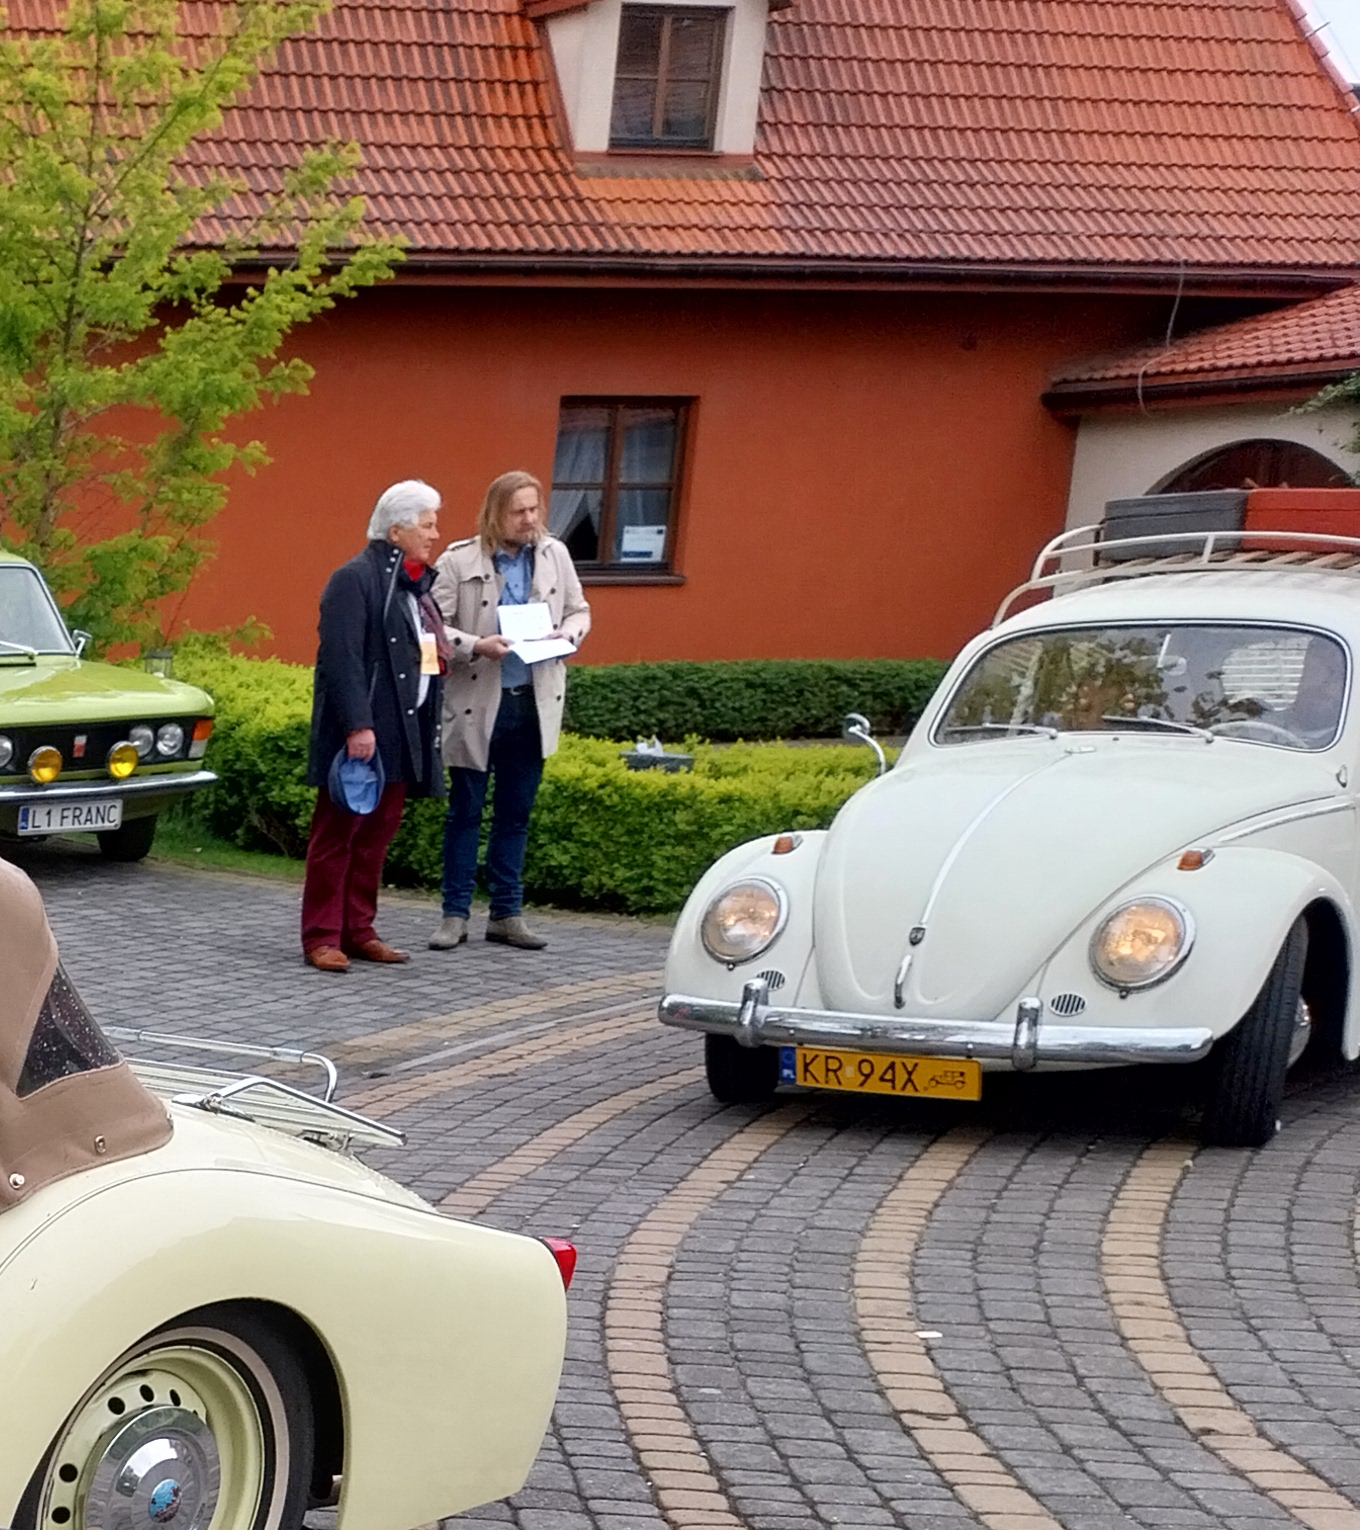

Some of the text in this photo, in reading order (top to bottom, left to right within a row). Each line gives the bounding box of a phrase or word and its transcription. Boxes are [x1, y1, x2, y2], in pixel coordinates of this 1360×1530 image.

[31, 804, 118, 829] L1 FRANC
[802, 1052, 920, 1093] KR 94X
